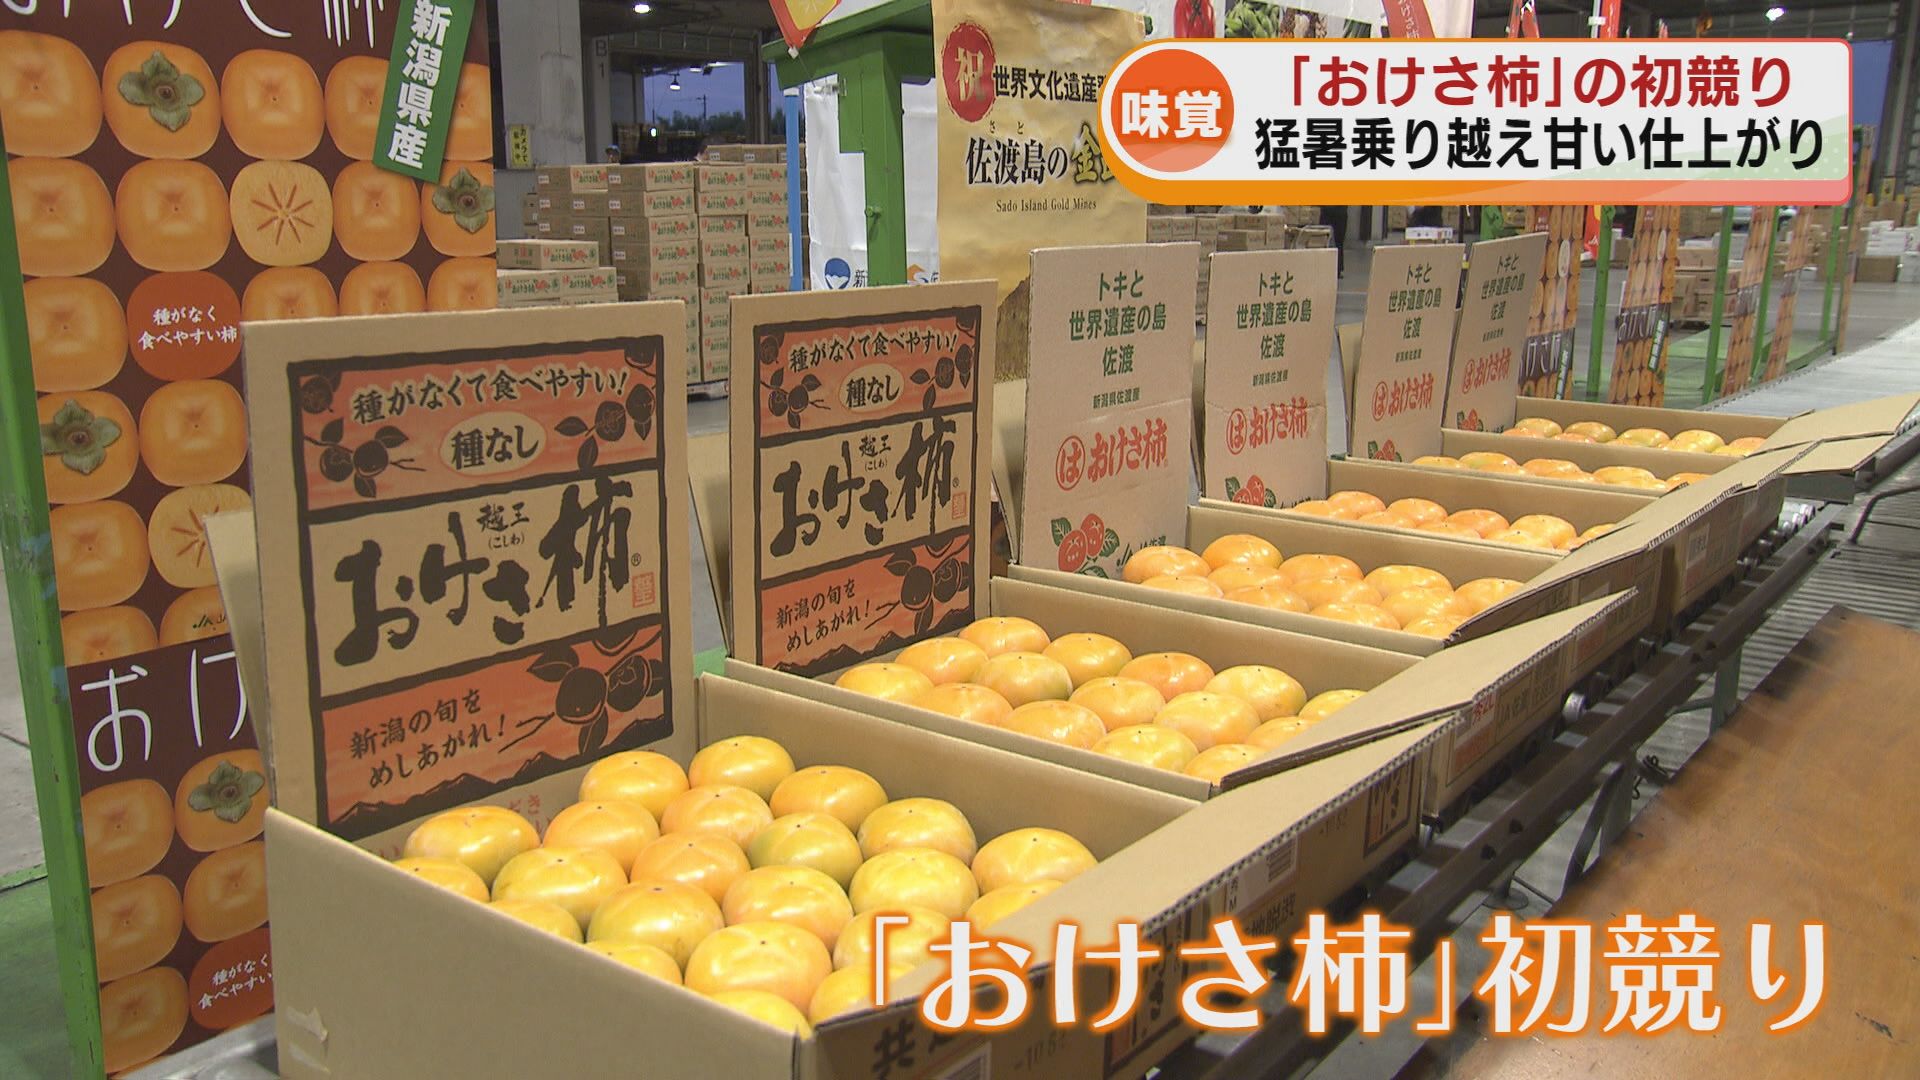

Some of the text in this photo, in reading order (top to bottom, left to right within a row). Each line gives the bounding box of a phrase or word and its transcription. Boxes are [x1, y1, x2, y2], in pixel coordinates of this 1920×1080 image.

[387, 0, 454, 170] 新潟県産
[954, 46, 985, 102] 祝
[965, 121, 1114, 185] 佐渡島の金
[996, 196, 1097, 213] Sado Island Gold Mines
[1406, 263, 1433, 286] トキと
[1497, 254, 1519, 275] トキと
[1098, 270, 1144, 301] トキと
[1258, 271, 1294, 297] トキと
[152, 305, 218, 327] 種がなく
[1069, 302, 1167, 342] 世界遺産の島
[1236, 298, 1312, 330] 世界遺産の島
[138, 326, 239, 351] 食べやすい柿
[1260, 333, 1286, 361] 佐渡
[1102, 343, 1135, 377] 佐渡
[352, 366, 630, 426] 種がなくて食べやすい!
[845, 375, 900, 409] 種なし
[1249, 396, 1308, 449] おけさ柿
[451, 424, 539, 471] 種なし
[1087, 417, 1168, 484] おけさ柿
[770, 416, 956, 558] おけさ柿
[477, 501, 531, 532] 越王
[333, 475, 632, 668] おけさ柿
[776, 578, 856, 630] 新潟の旬を
[350, 688, 482, 760] 新潟の旬を
[212, 953, 269, 987] 種がなく
